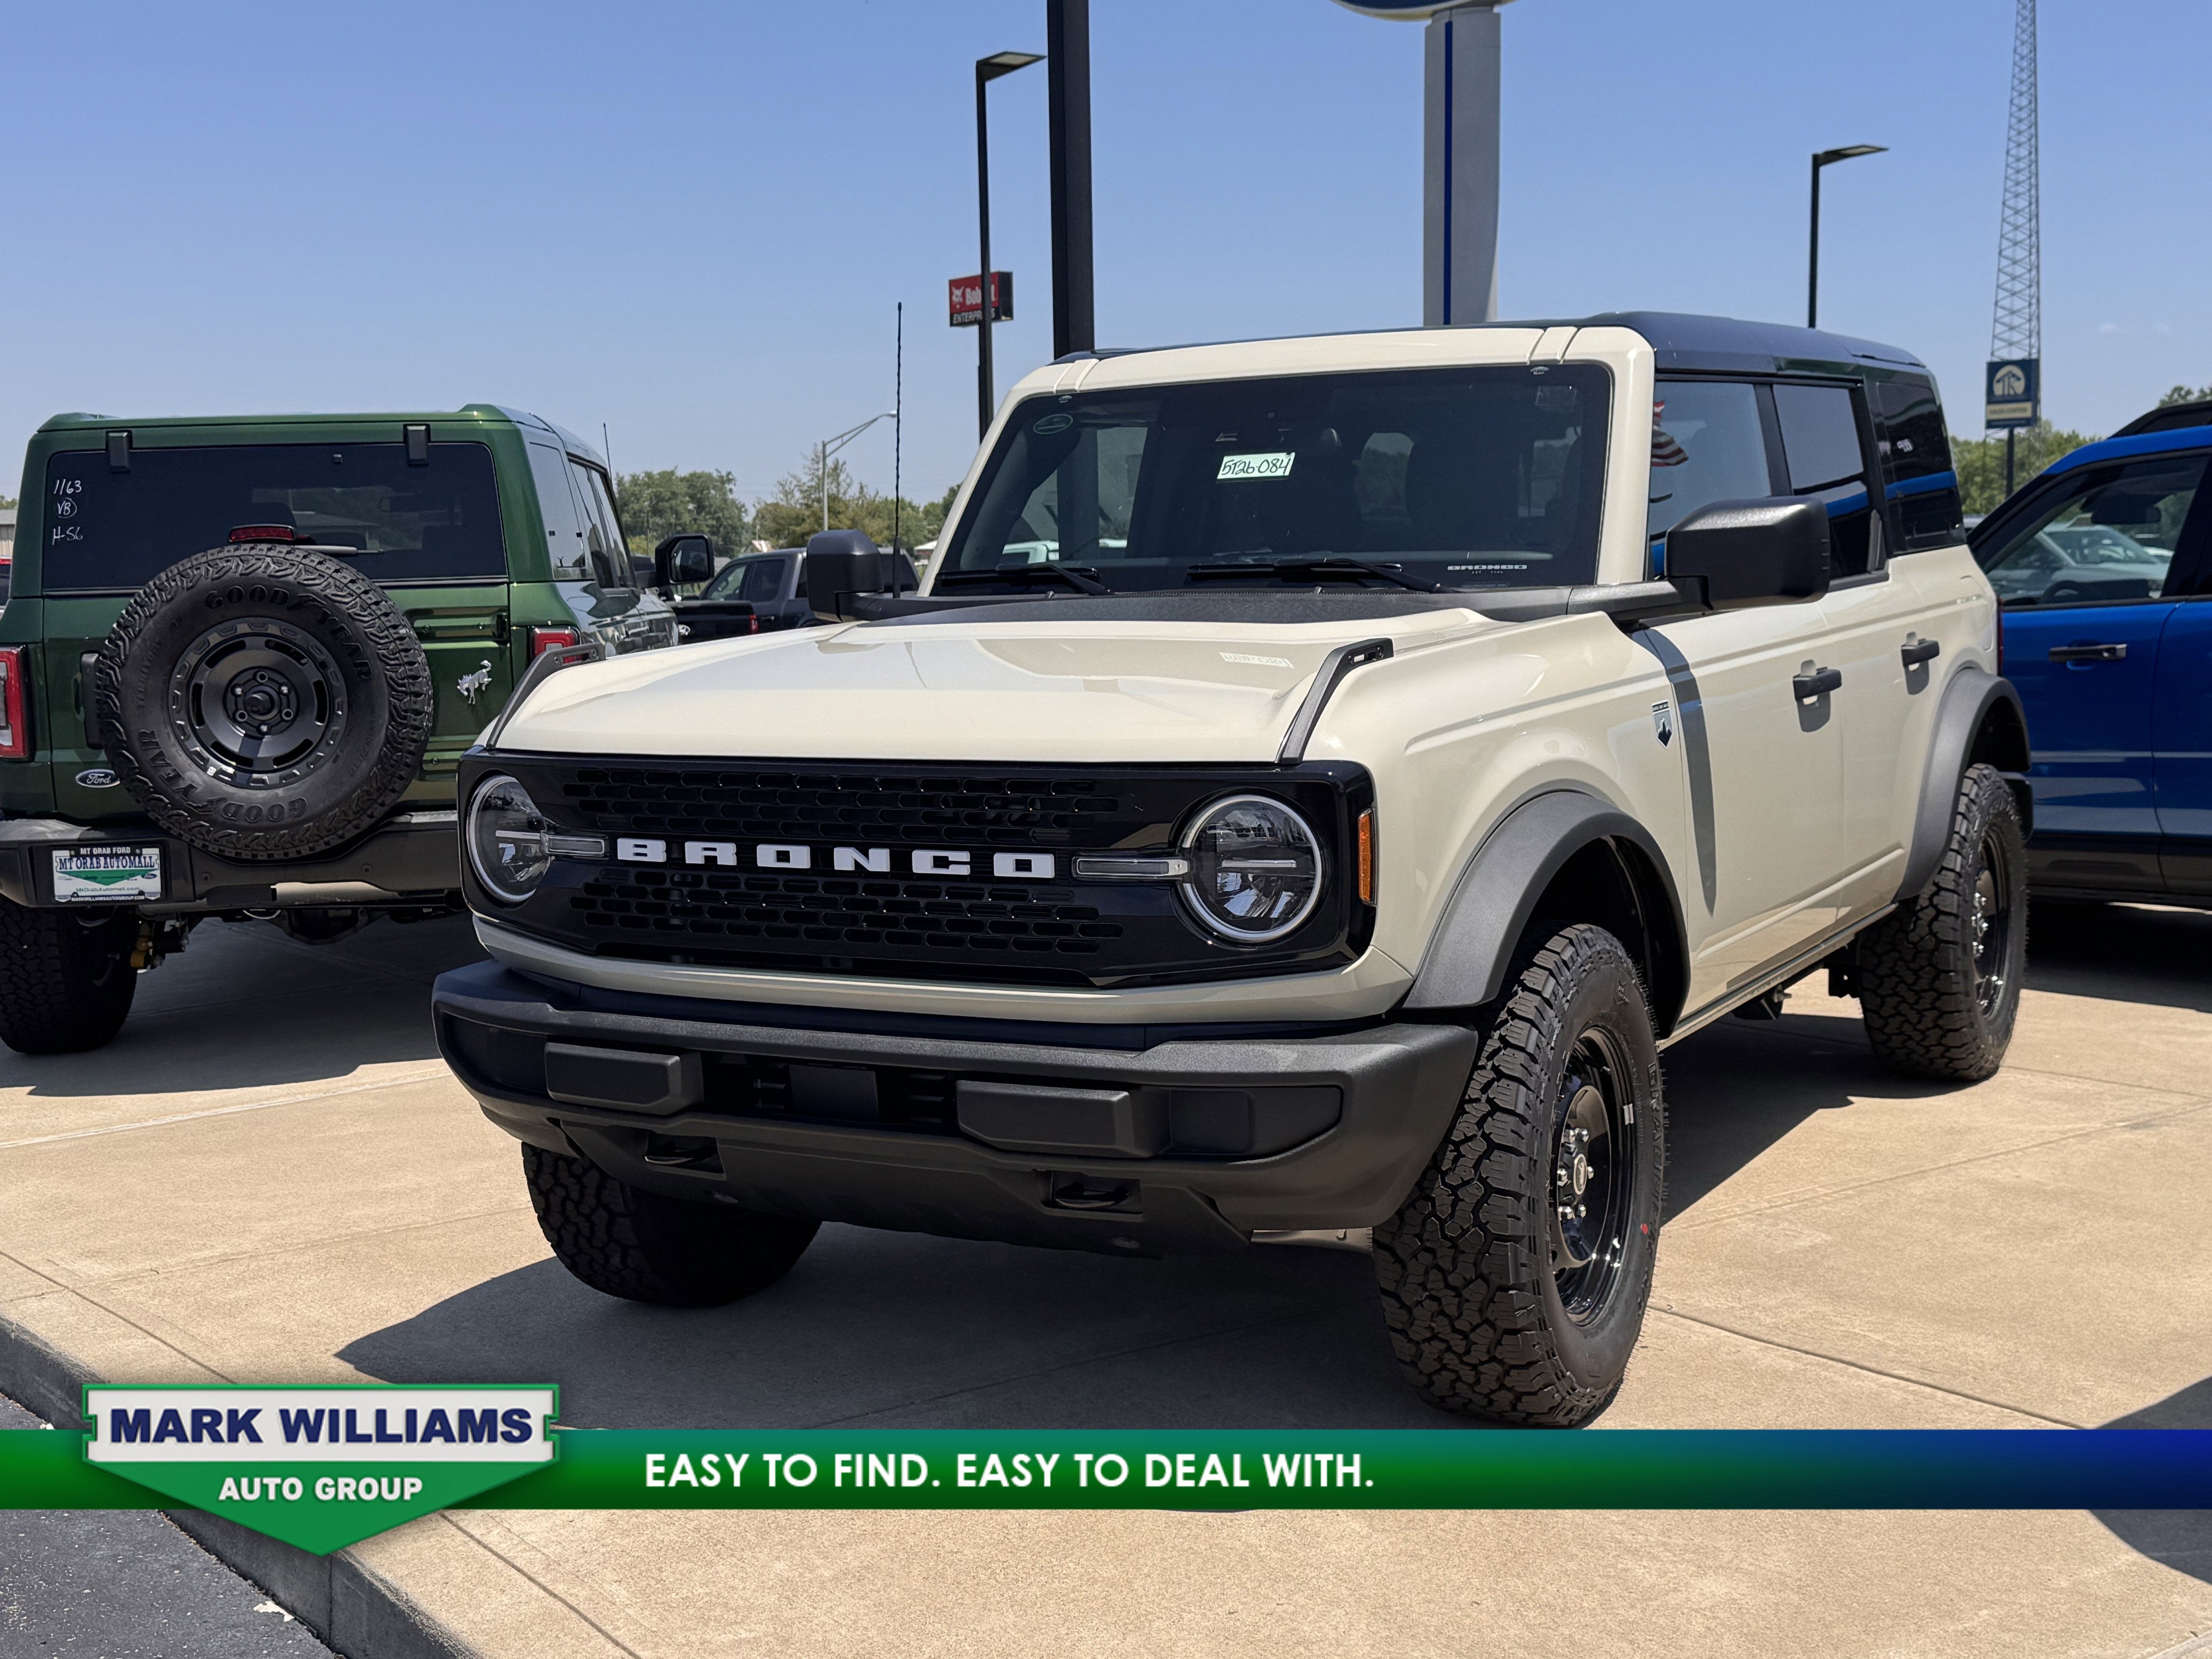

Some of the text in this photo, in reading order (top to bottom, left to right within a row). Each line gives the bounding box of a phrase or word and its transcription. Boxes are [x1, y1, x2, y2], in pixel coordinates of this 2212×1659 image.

[54, 479, 82, 495] 1163
[59, 857, 74, 870] MT
[76, 856, 101, 869] ORAB
[617, 838, 1054, 878] BRONCO
